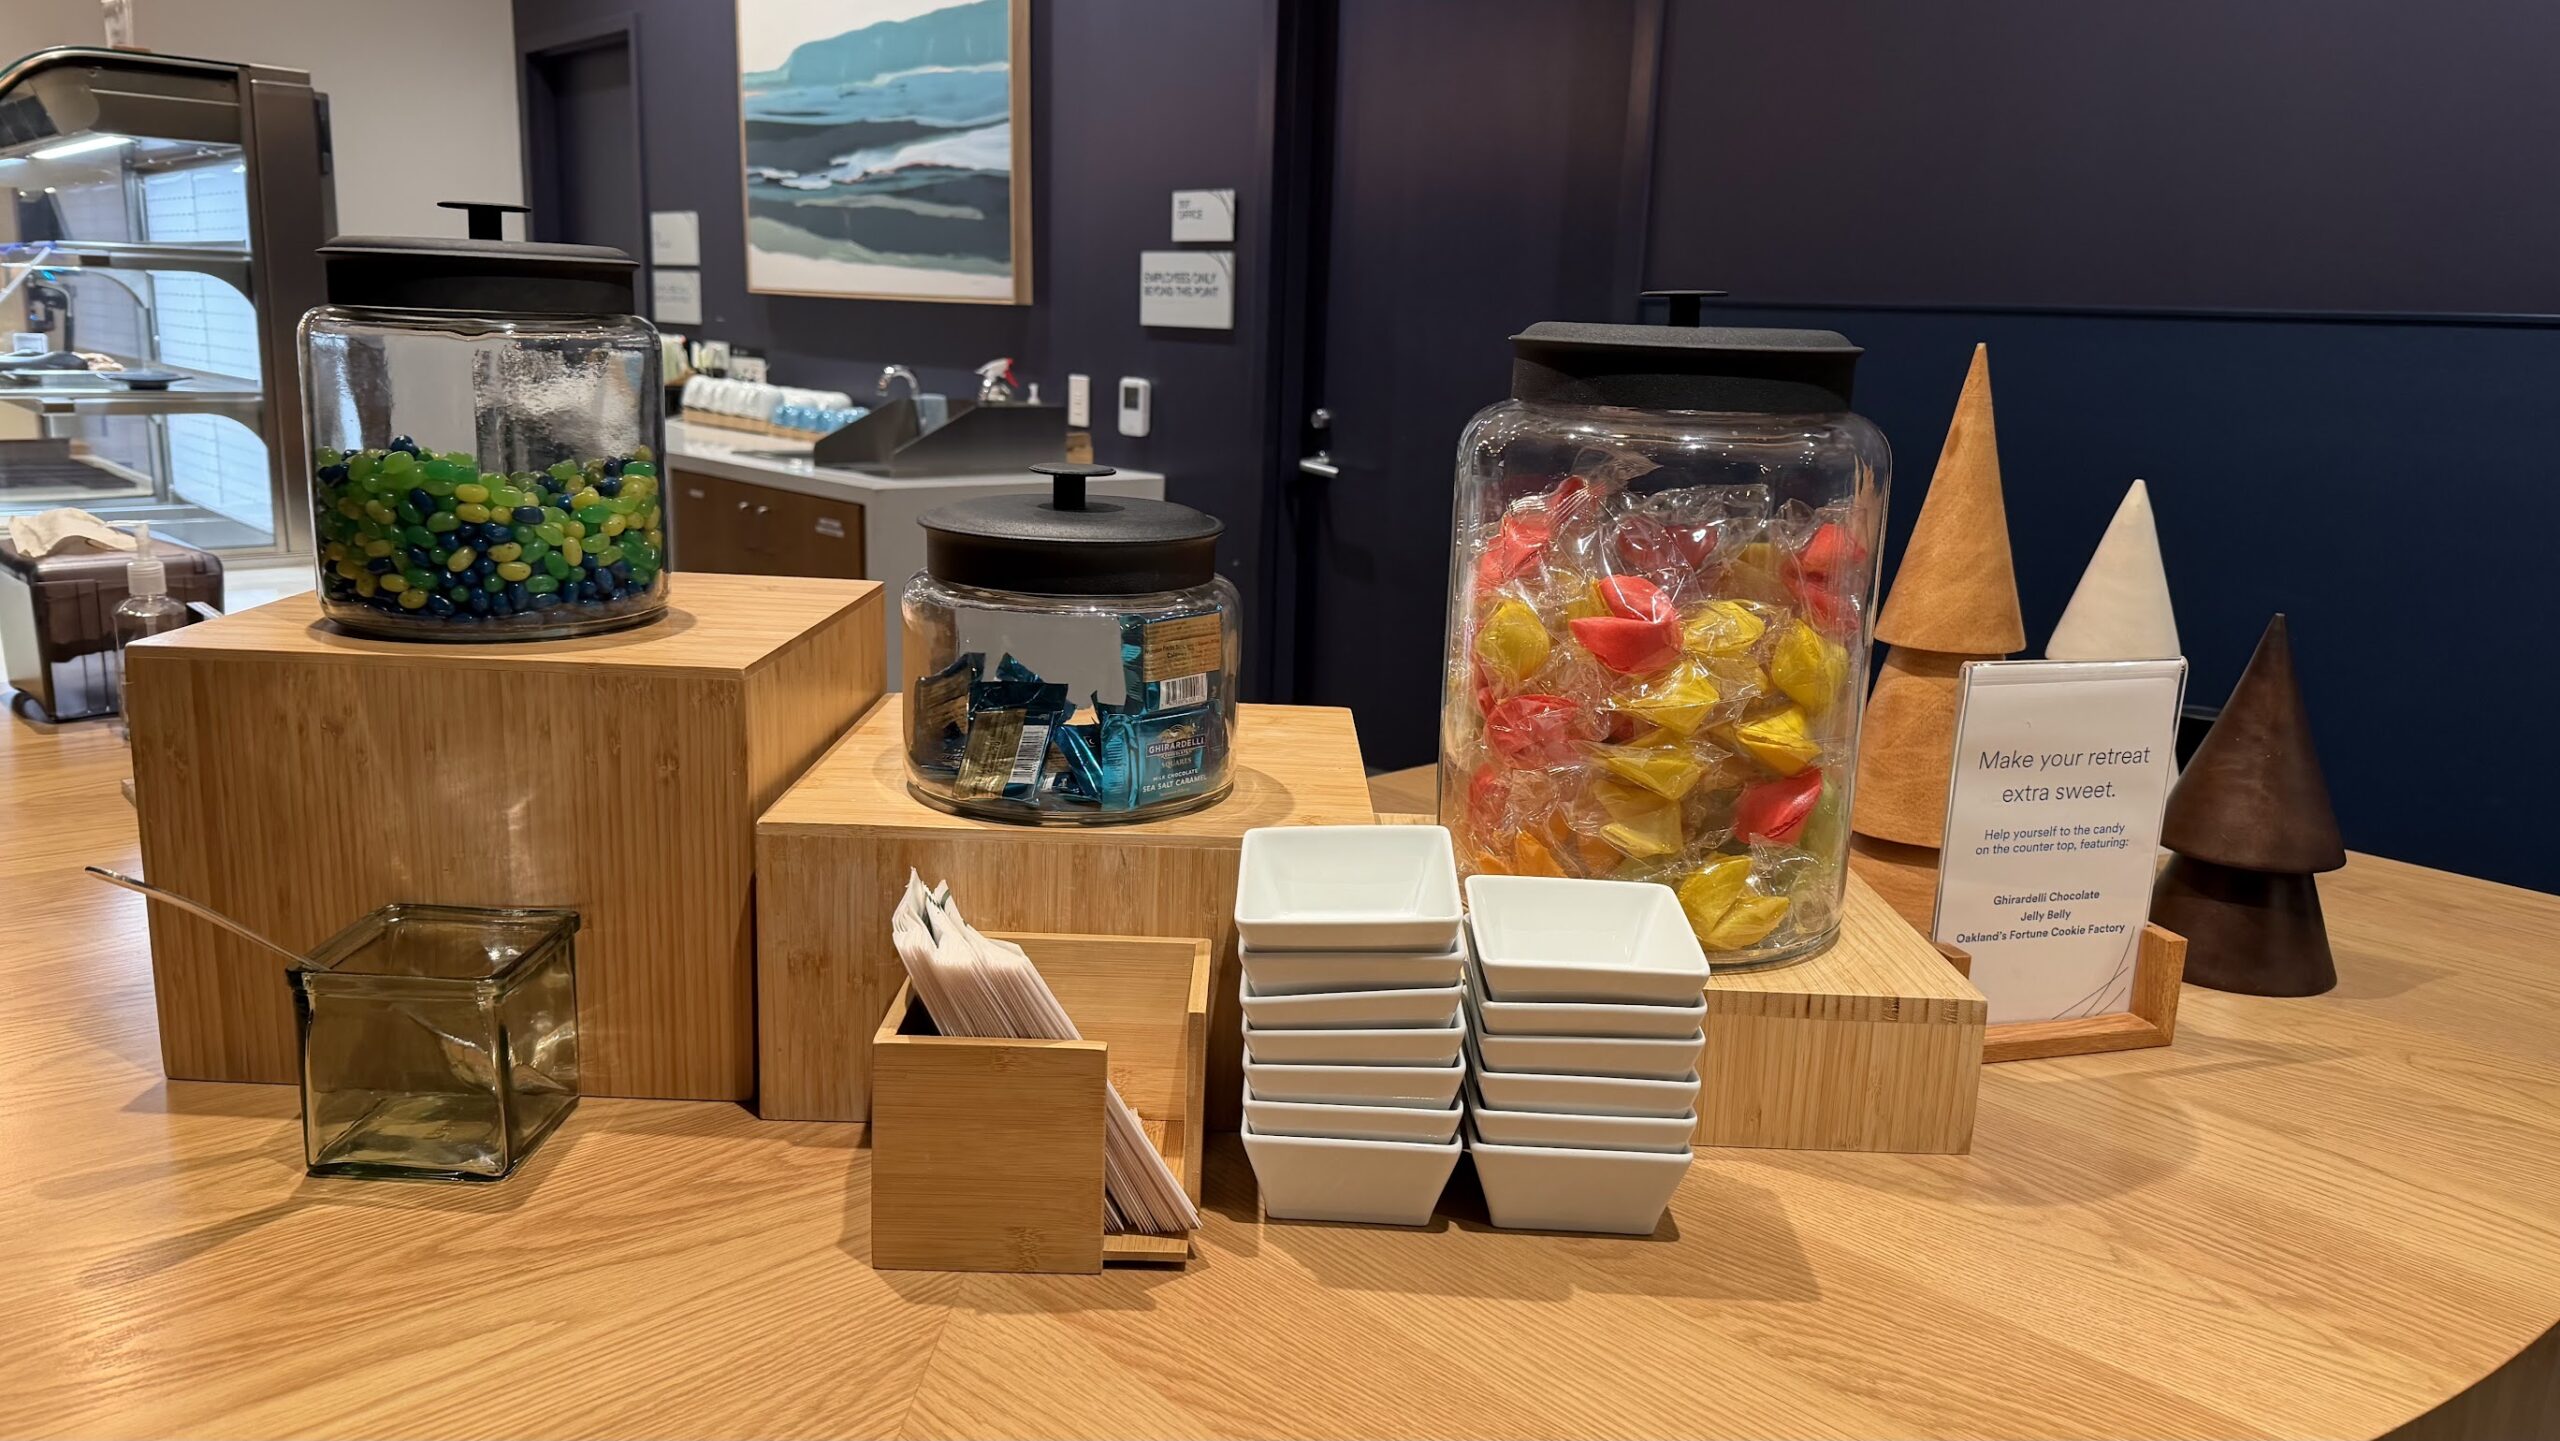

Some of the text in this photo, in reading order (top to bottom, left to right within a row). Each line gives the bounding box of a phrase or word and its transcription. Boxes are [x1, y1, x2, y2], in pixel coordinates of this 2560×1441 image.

[1149, 737, 1204, 754] GHIRARDELLI
[1979, 747, 2150, 771] Make your retreat
[1167, 769, 1198, 779] CHOCOLATE
[1142, 785, 1156, 793] SEA
[1157, 780, 1174, 790] SALT
[1175, 775, 1207, 786] CARAMEL
[2002, 781, 2115, 802] extra sweet.
[1984, 822, 2125, 841] Help yourself to the candy
[1975, 836, 2129, 855] on the counter top, featuring:
[1993, 889, 2100, 906] Ghirardelli Chocolate
[2020, 909, 2071, 922] Jelly Belly
[1956, 924, 2125, 943] Oakland's Fortune Cookie Factory
